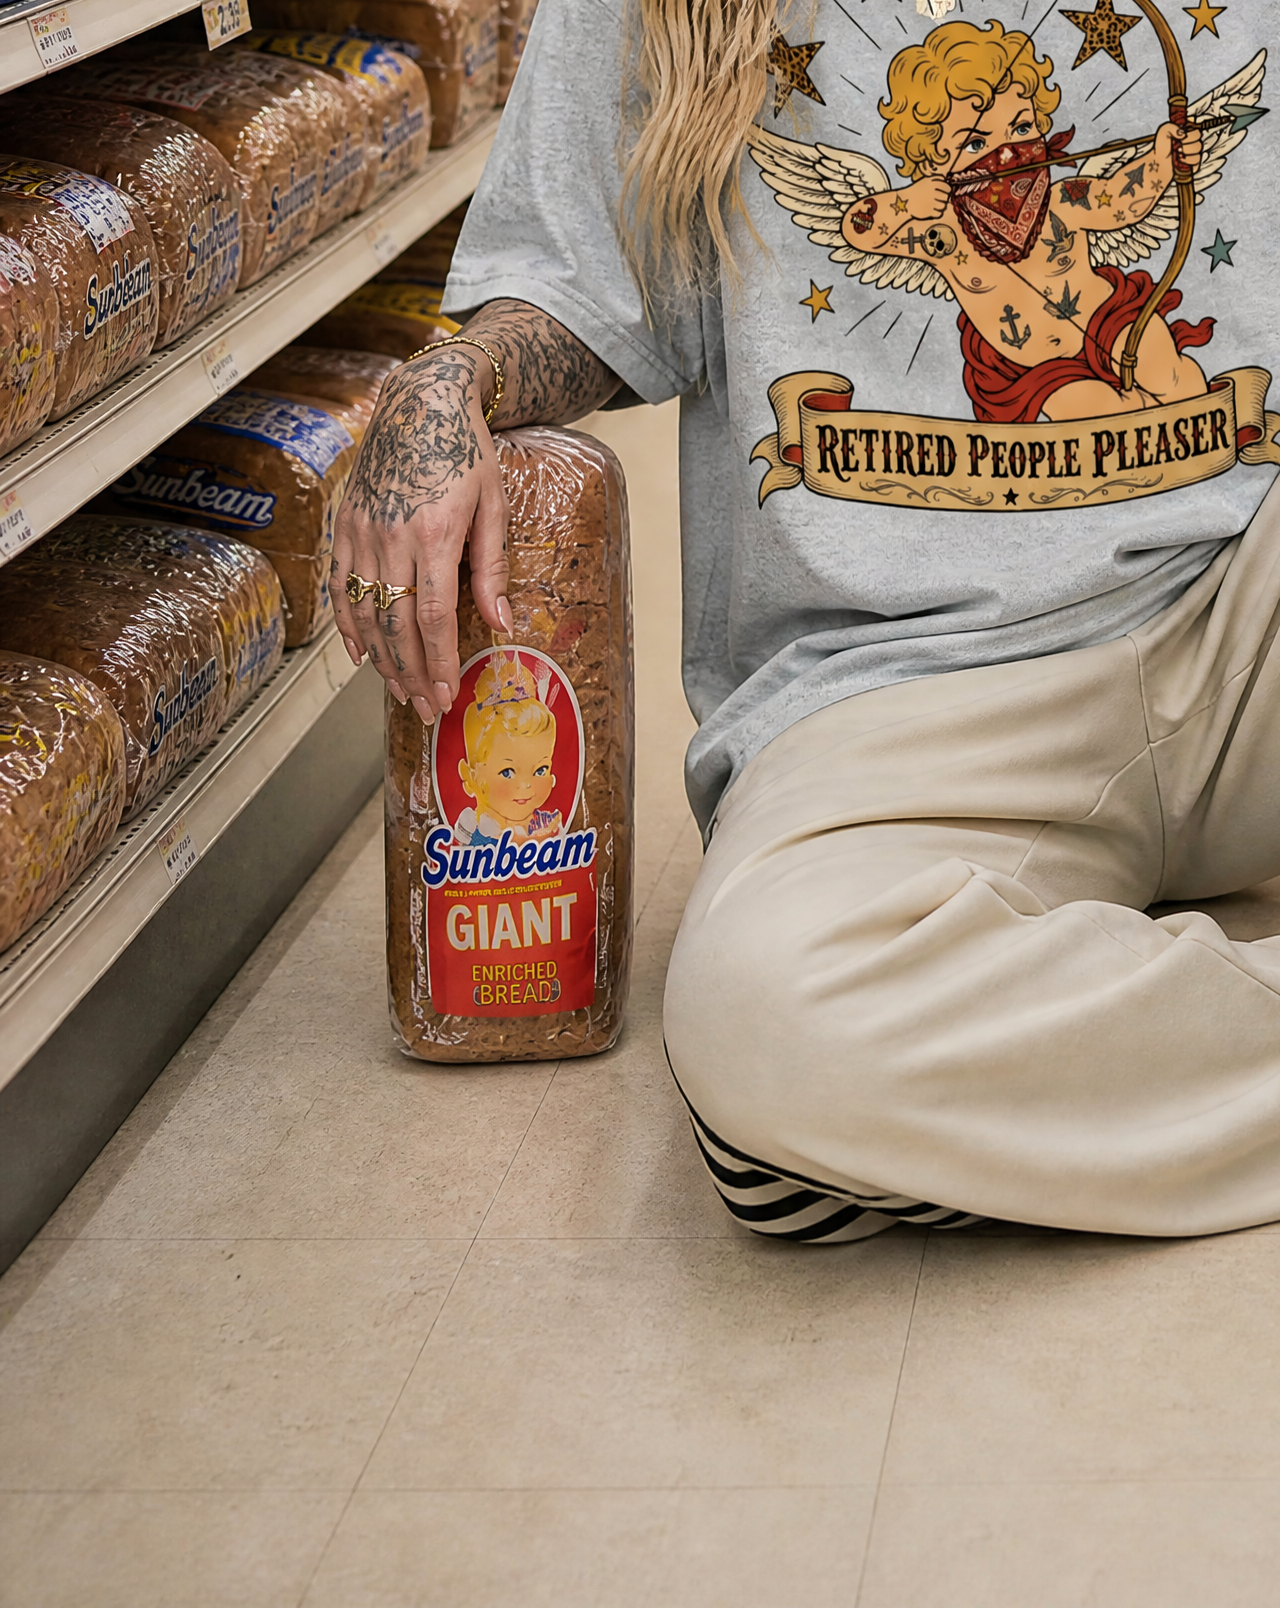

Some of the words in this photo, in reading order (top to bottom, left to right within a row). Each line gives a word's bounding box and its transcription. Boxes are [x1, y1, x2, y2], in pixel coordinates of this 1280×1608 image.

[815, 424, 958, 482] RETIRED
[966, 433, 1082, 479] PEOPLE
[1090, 407, 1231, 479] PLEASER
[422, 826, 596, 887] Sunbeam
[445, 892, 578, 952] GIANT
[472, 961, 558, 982] ENRICHED
